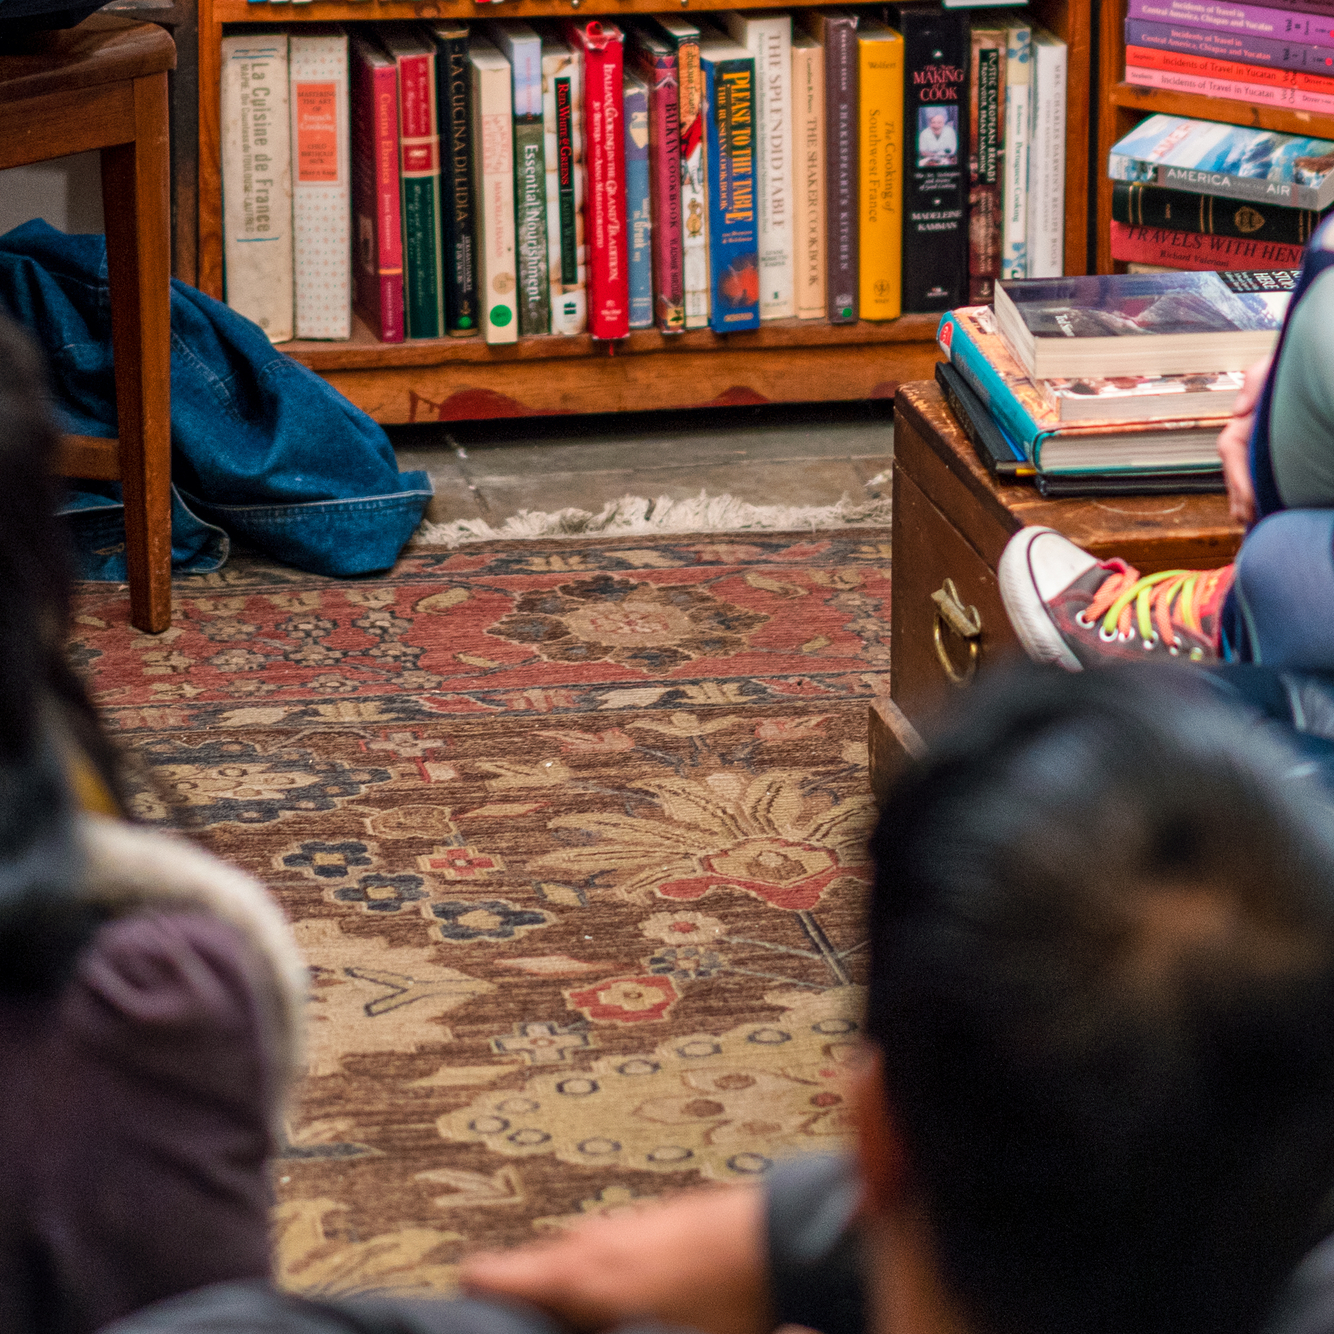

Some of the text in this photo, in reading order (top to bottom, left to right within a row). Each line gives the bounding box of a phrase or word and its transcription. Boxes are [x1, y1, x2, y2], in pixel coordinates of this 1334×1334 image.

[525, 145, 541, 302] Essential Nourishment
[723, 70, 753, 224] PLEASE TO THE TABLE
